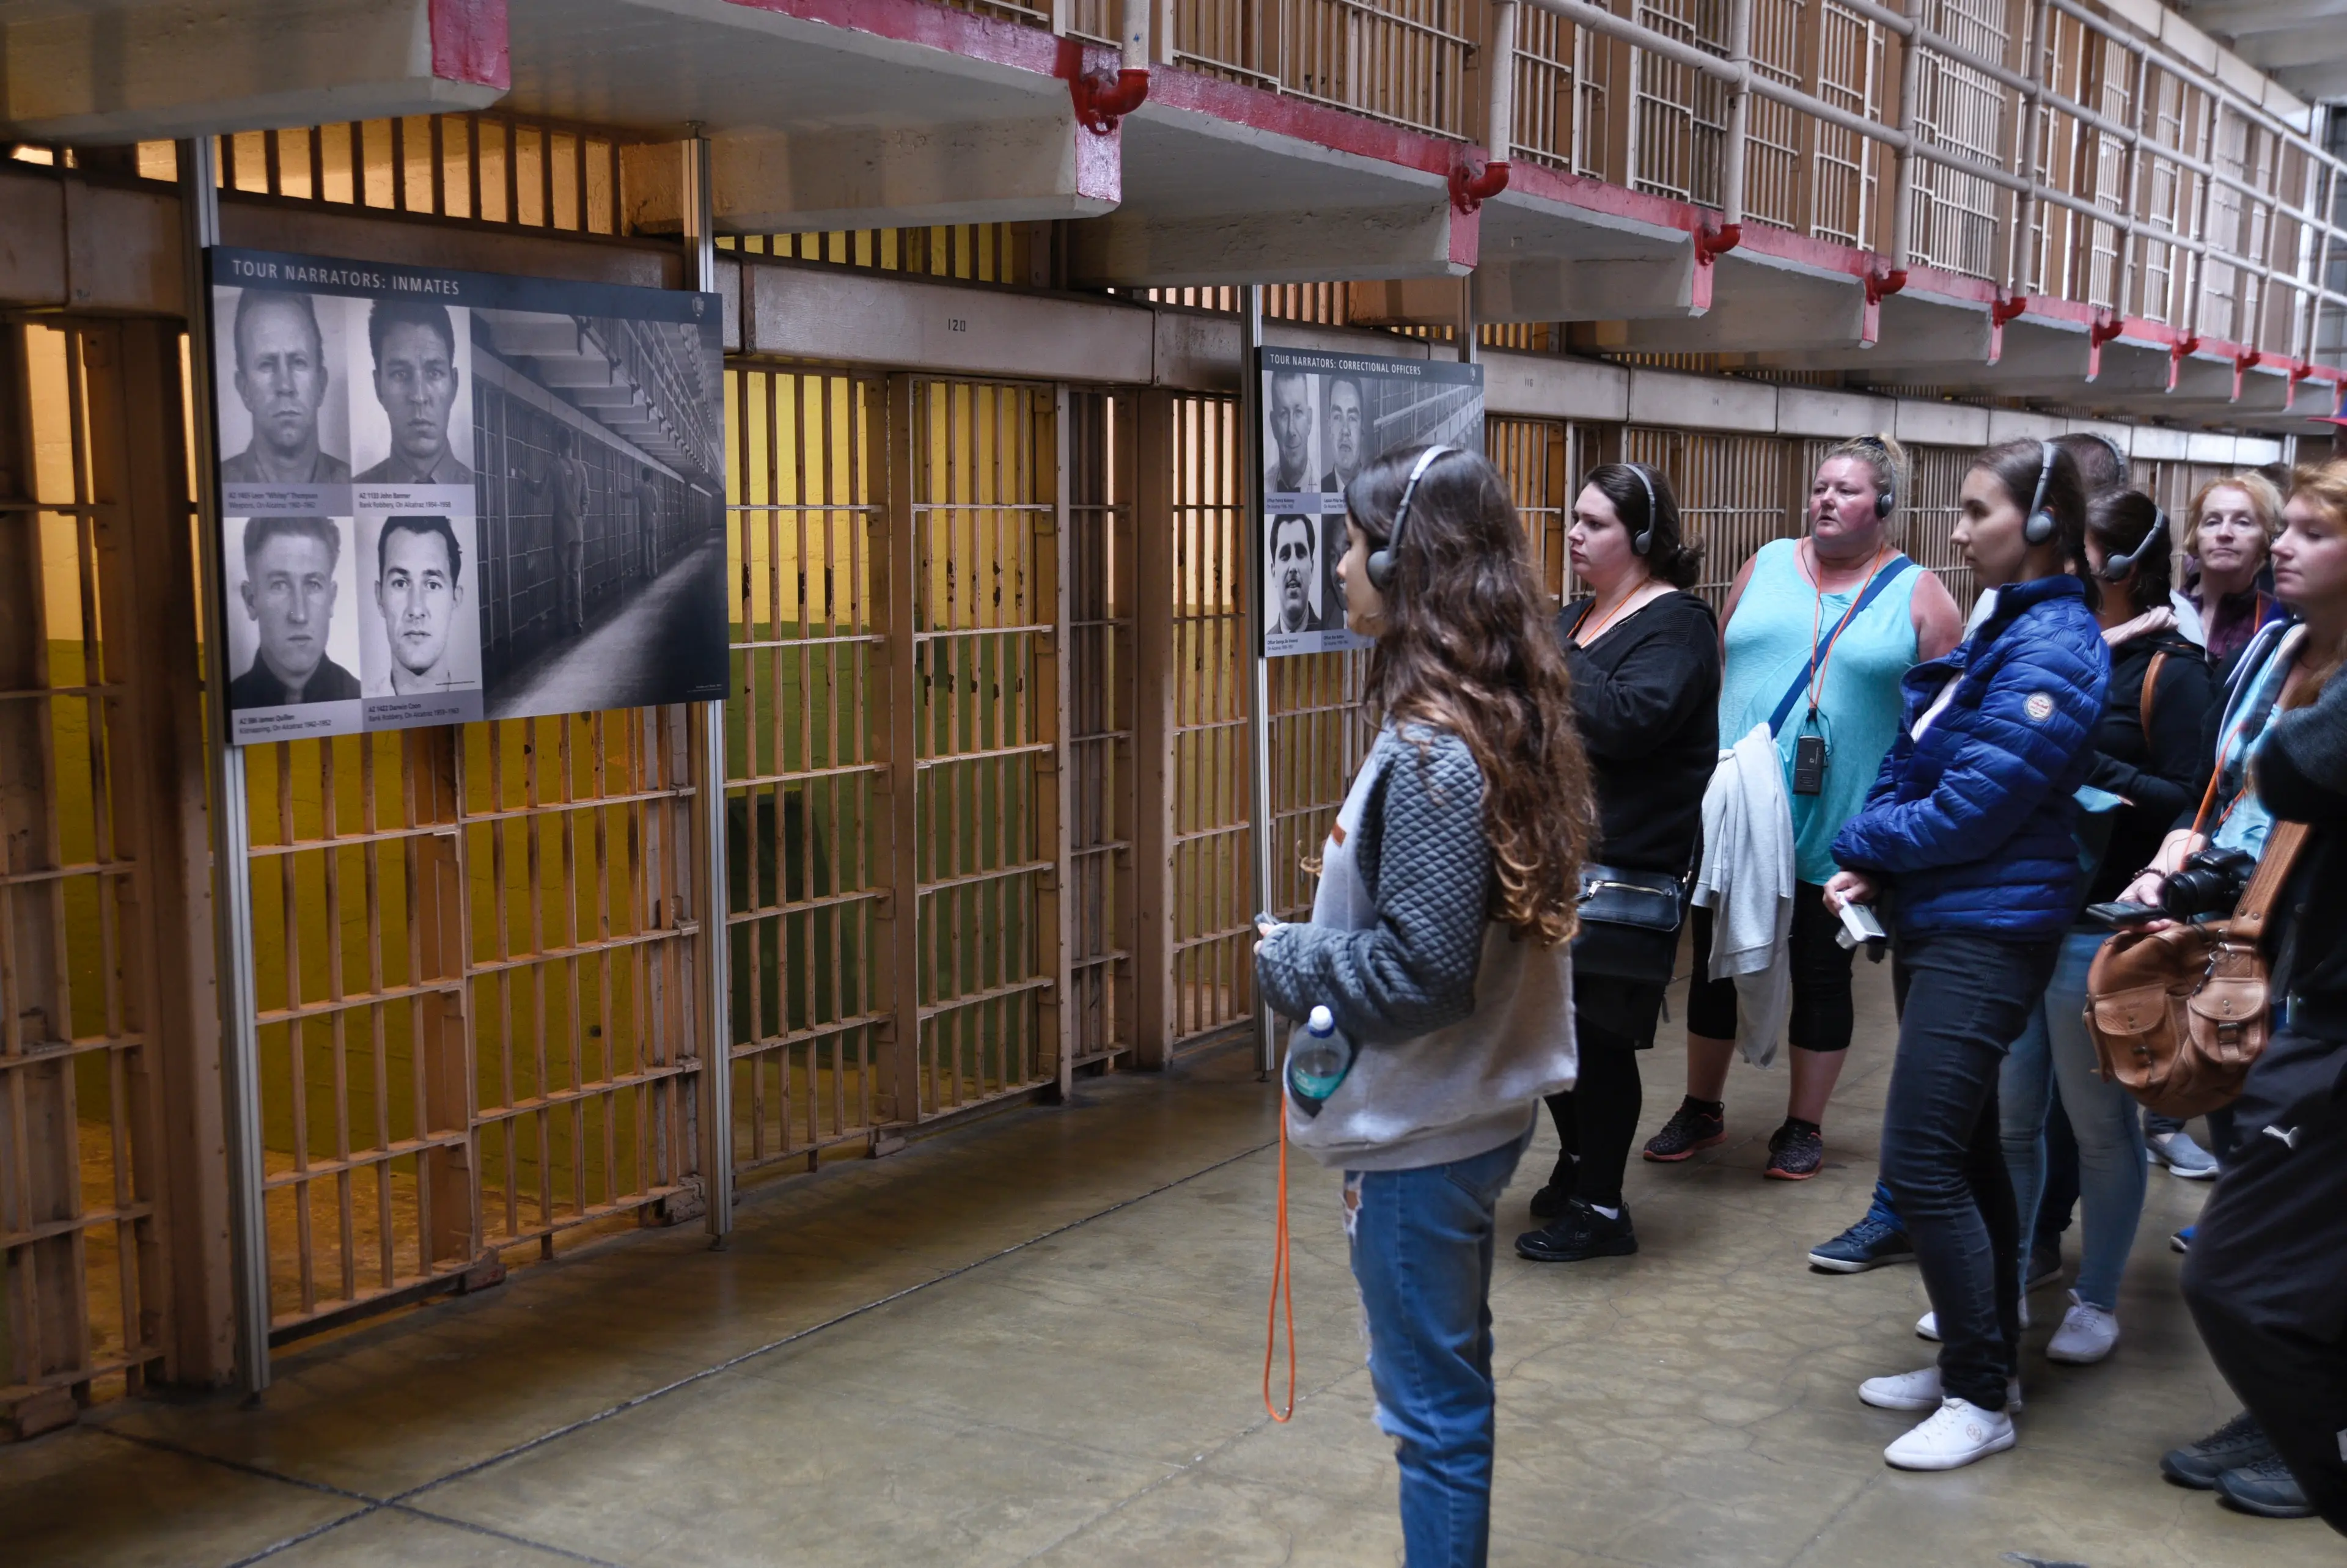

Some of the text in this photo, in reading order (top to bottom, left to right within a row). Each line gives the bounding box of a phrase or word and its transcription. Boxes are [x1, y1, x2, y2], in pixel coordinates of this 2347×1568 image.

[232, 260, 460, 295] TOUR NARRATORS: INMATES
[948, 318, 966, 332] 120
[1270, 354, 1421, 375] TOUR NARRATORS: CORRECTIONAL OFFICERS
